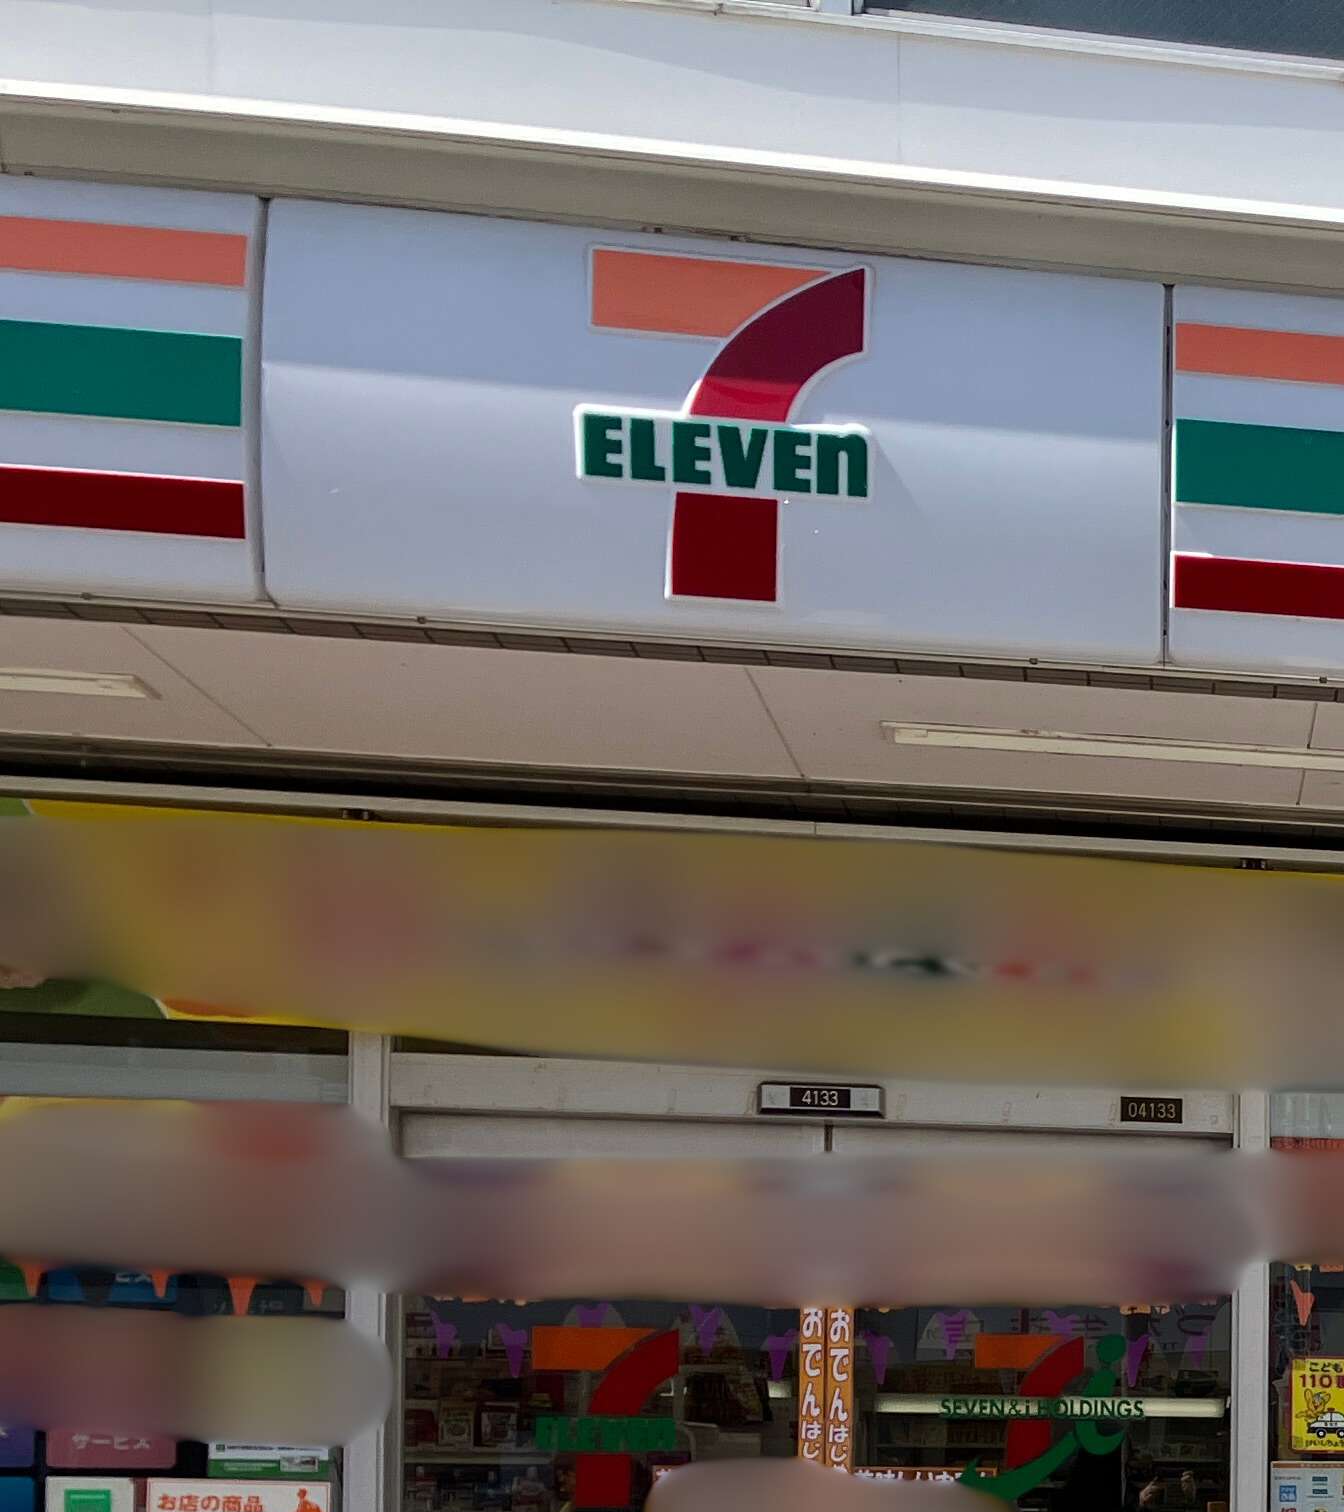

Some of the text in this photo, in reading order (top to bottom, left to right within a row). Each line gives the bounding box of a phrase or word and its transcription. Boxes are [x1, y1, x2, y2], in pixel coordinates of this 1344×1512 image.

[801, 1090, 839, 1106] 4133
[1127, 1101, 1176, 1119] 04133
[1308, 1361, 1344, 1373] こども
[1037, 1399, 1144, 1420] HOLDINGS
